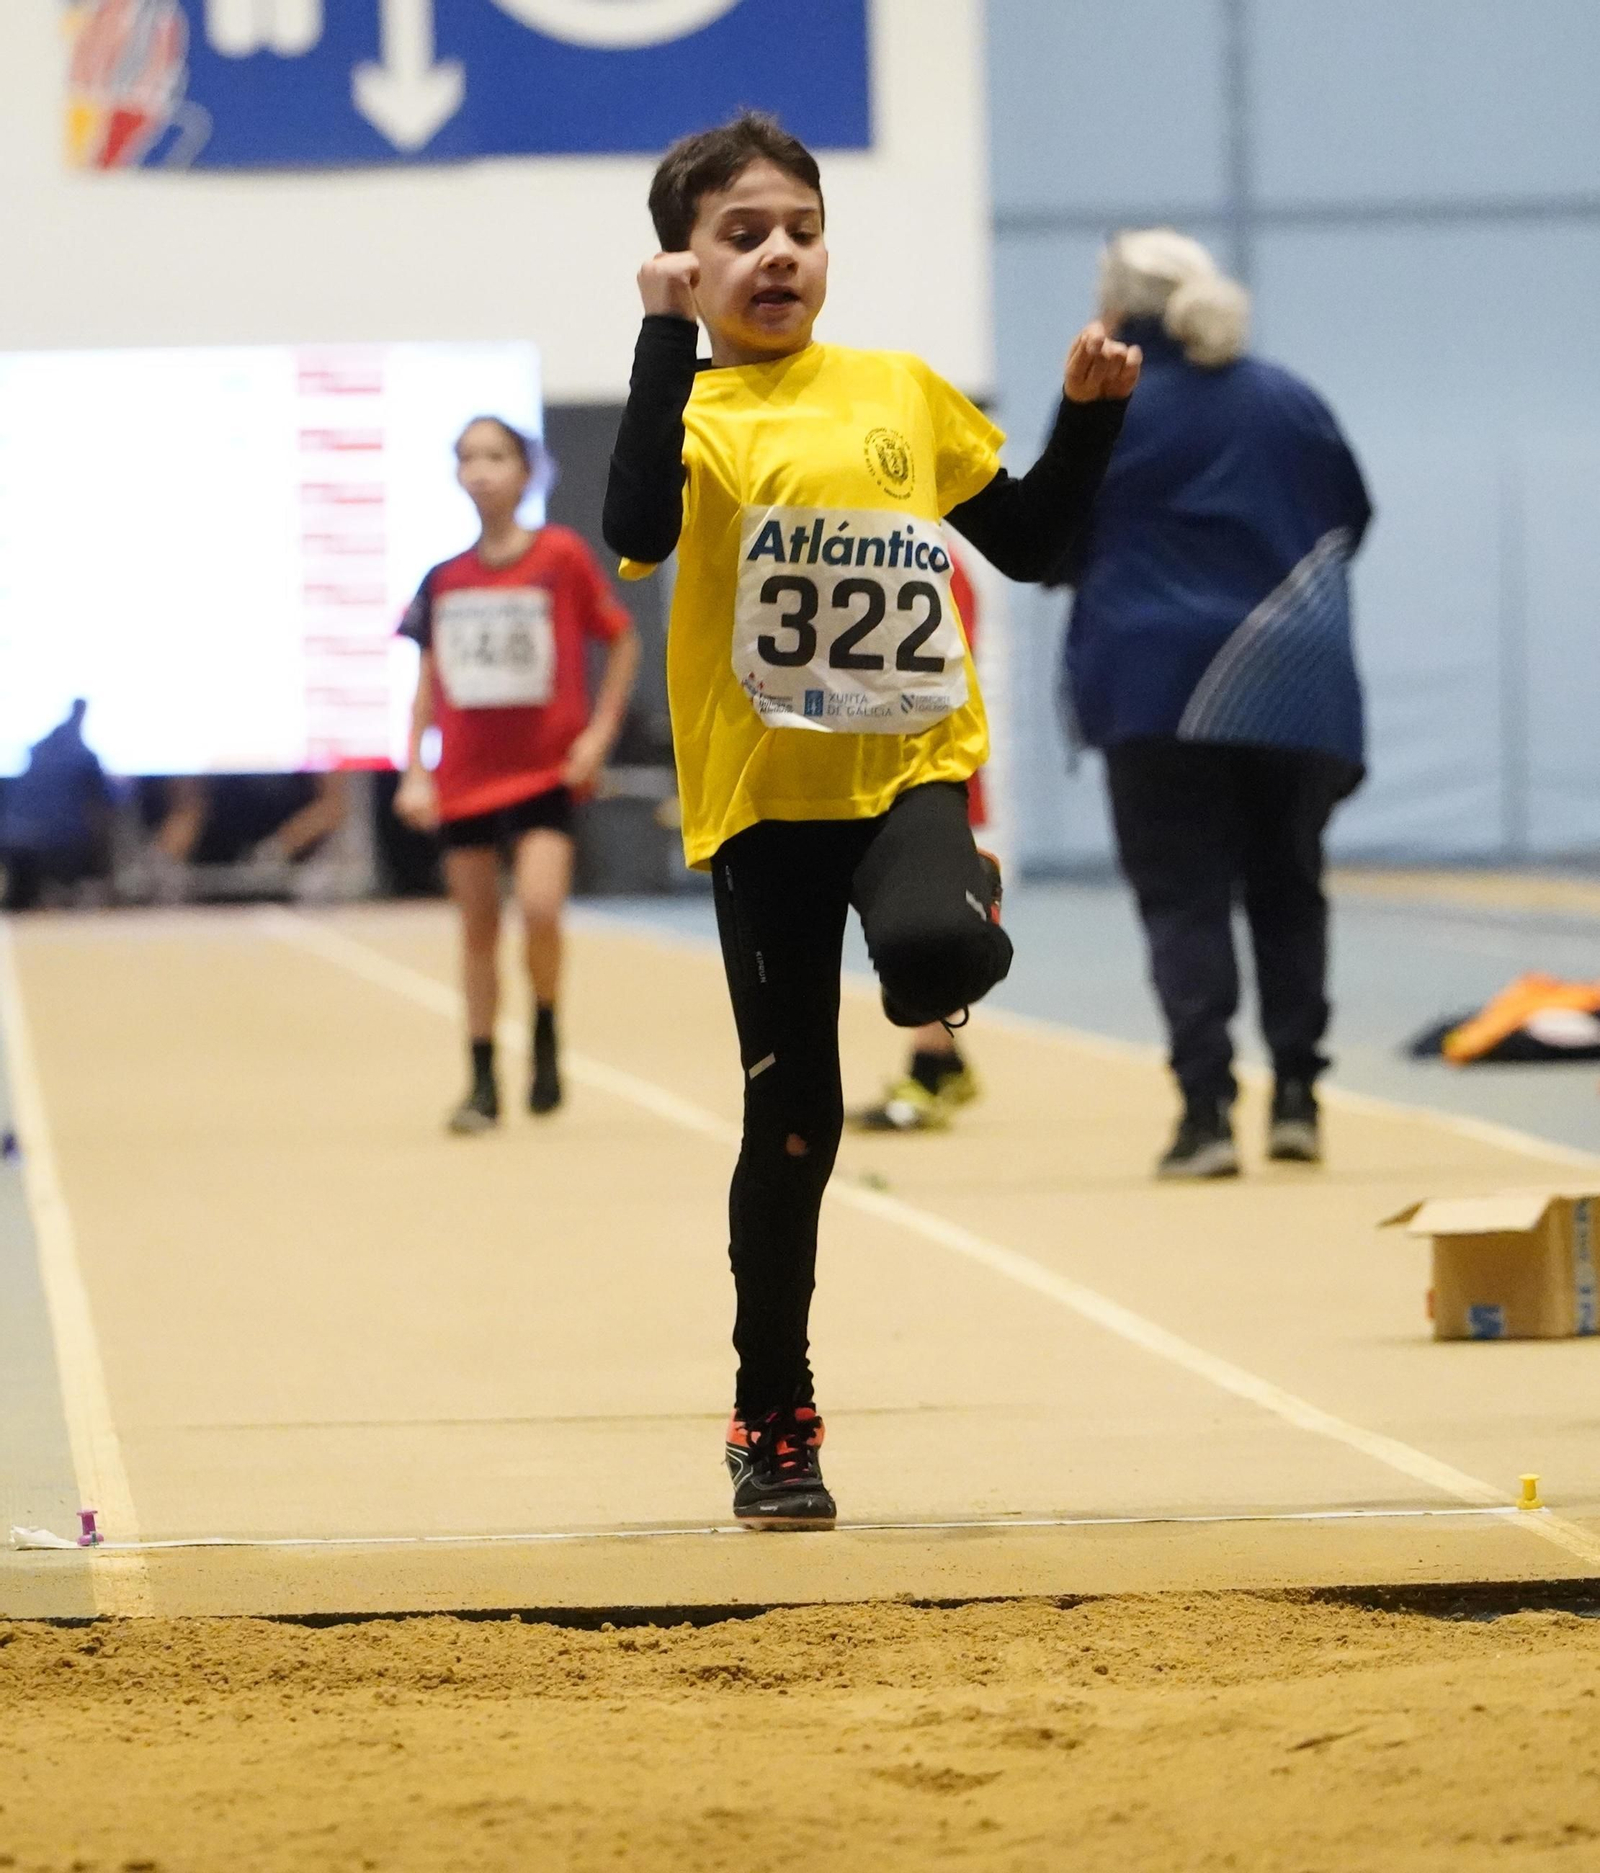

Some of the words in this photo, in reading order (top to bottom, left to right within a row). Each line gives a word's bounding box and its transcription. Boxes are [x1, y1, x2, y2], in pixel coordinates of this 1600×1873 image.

[747, 518, 950, 574] Atlántico
[757, 575, 945, 673] 322
[827, 705, 841, 716] DE
[847, 705, 892, 717] GALICIA
[829, 692, 868, 704] XUNTA
